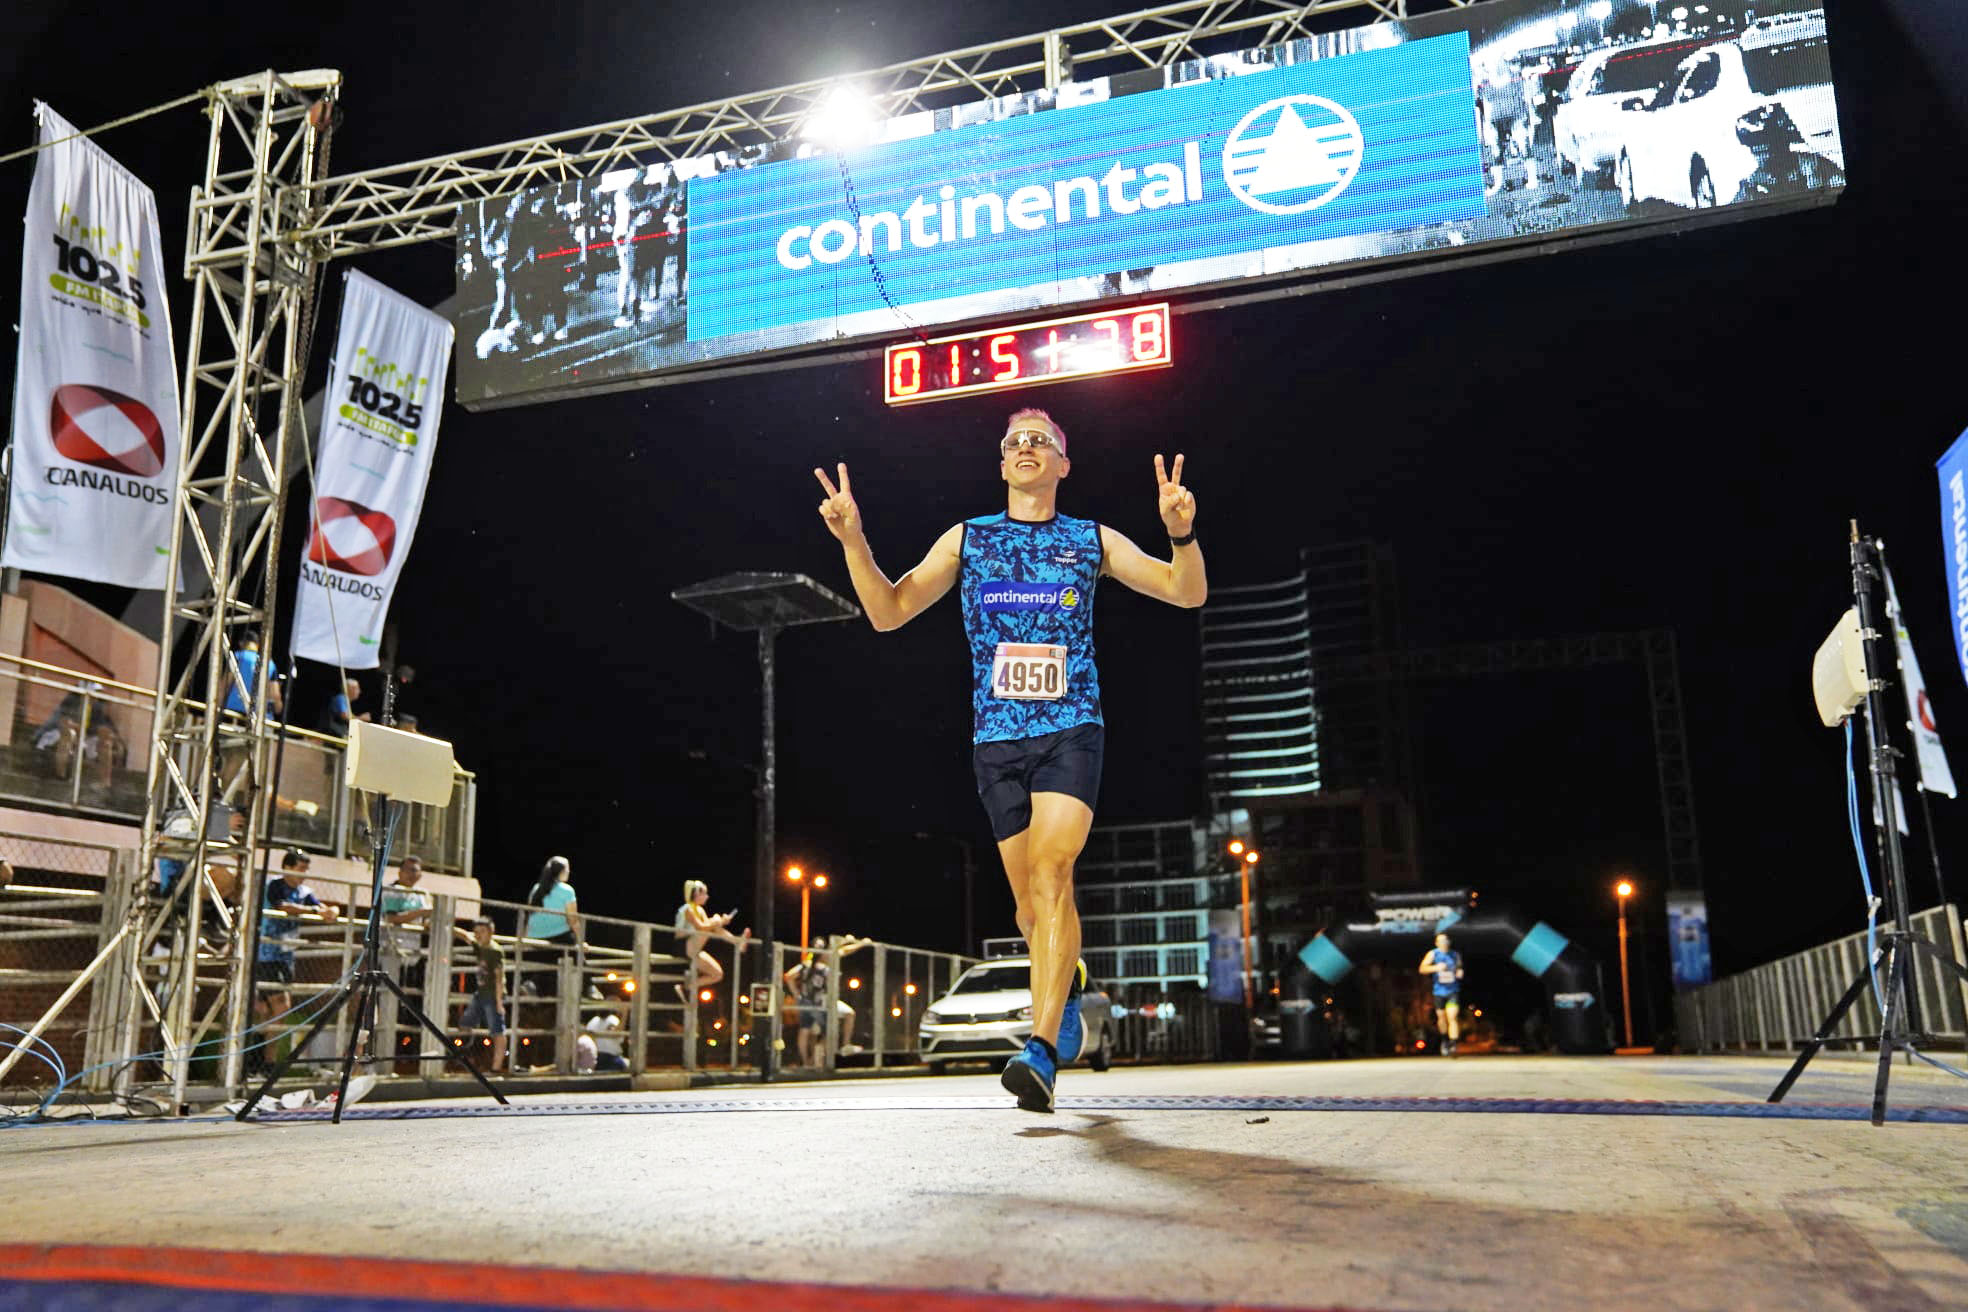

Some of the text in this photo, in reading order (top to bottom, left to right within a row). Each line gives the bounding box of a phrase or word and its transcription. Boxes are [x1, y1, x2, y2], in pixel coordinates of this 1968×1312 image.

[776, 141, 1203, 270] continental
[46, 467, 169, 505] CANALDOS
[984, 589, 1057, 605] continental
[997, 661, 1059, 694] 4950
